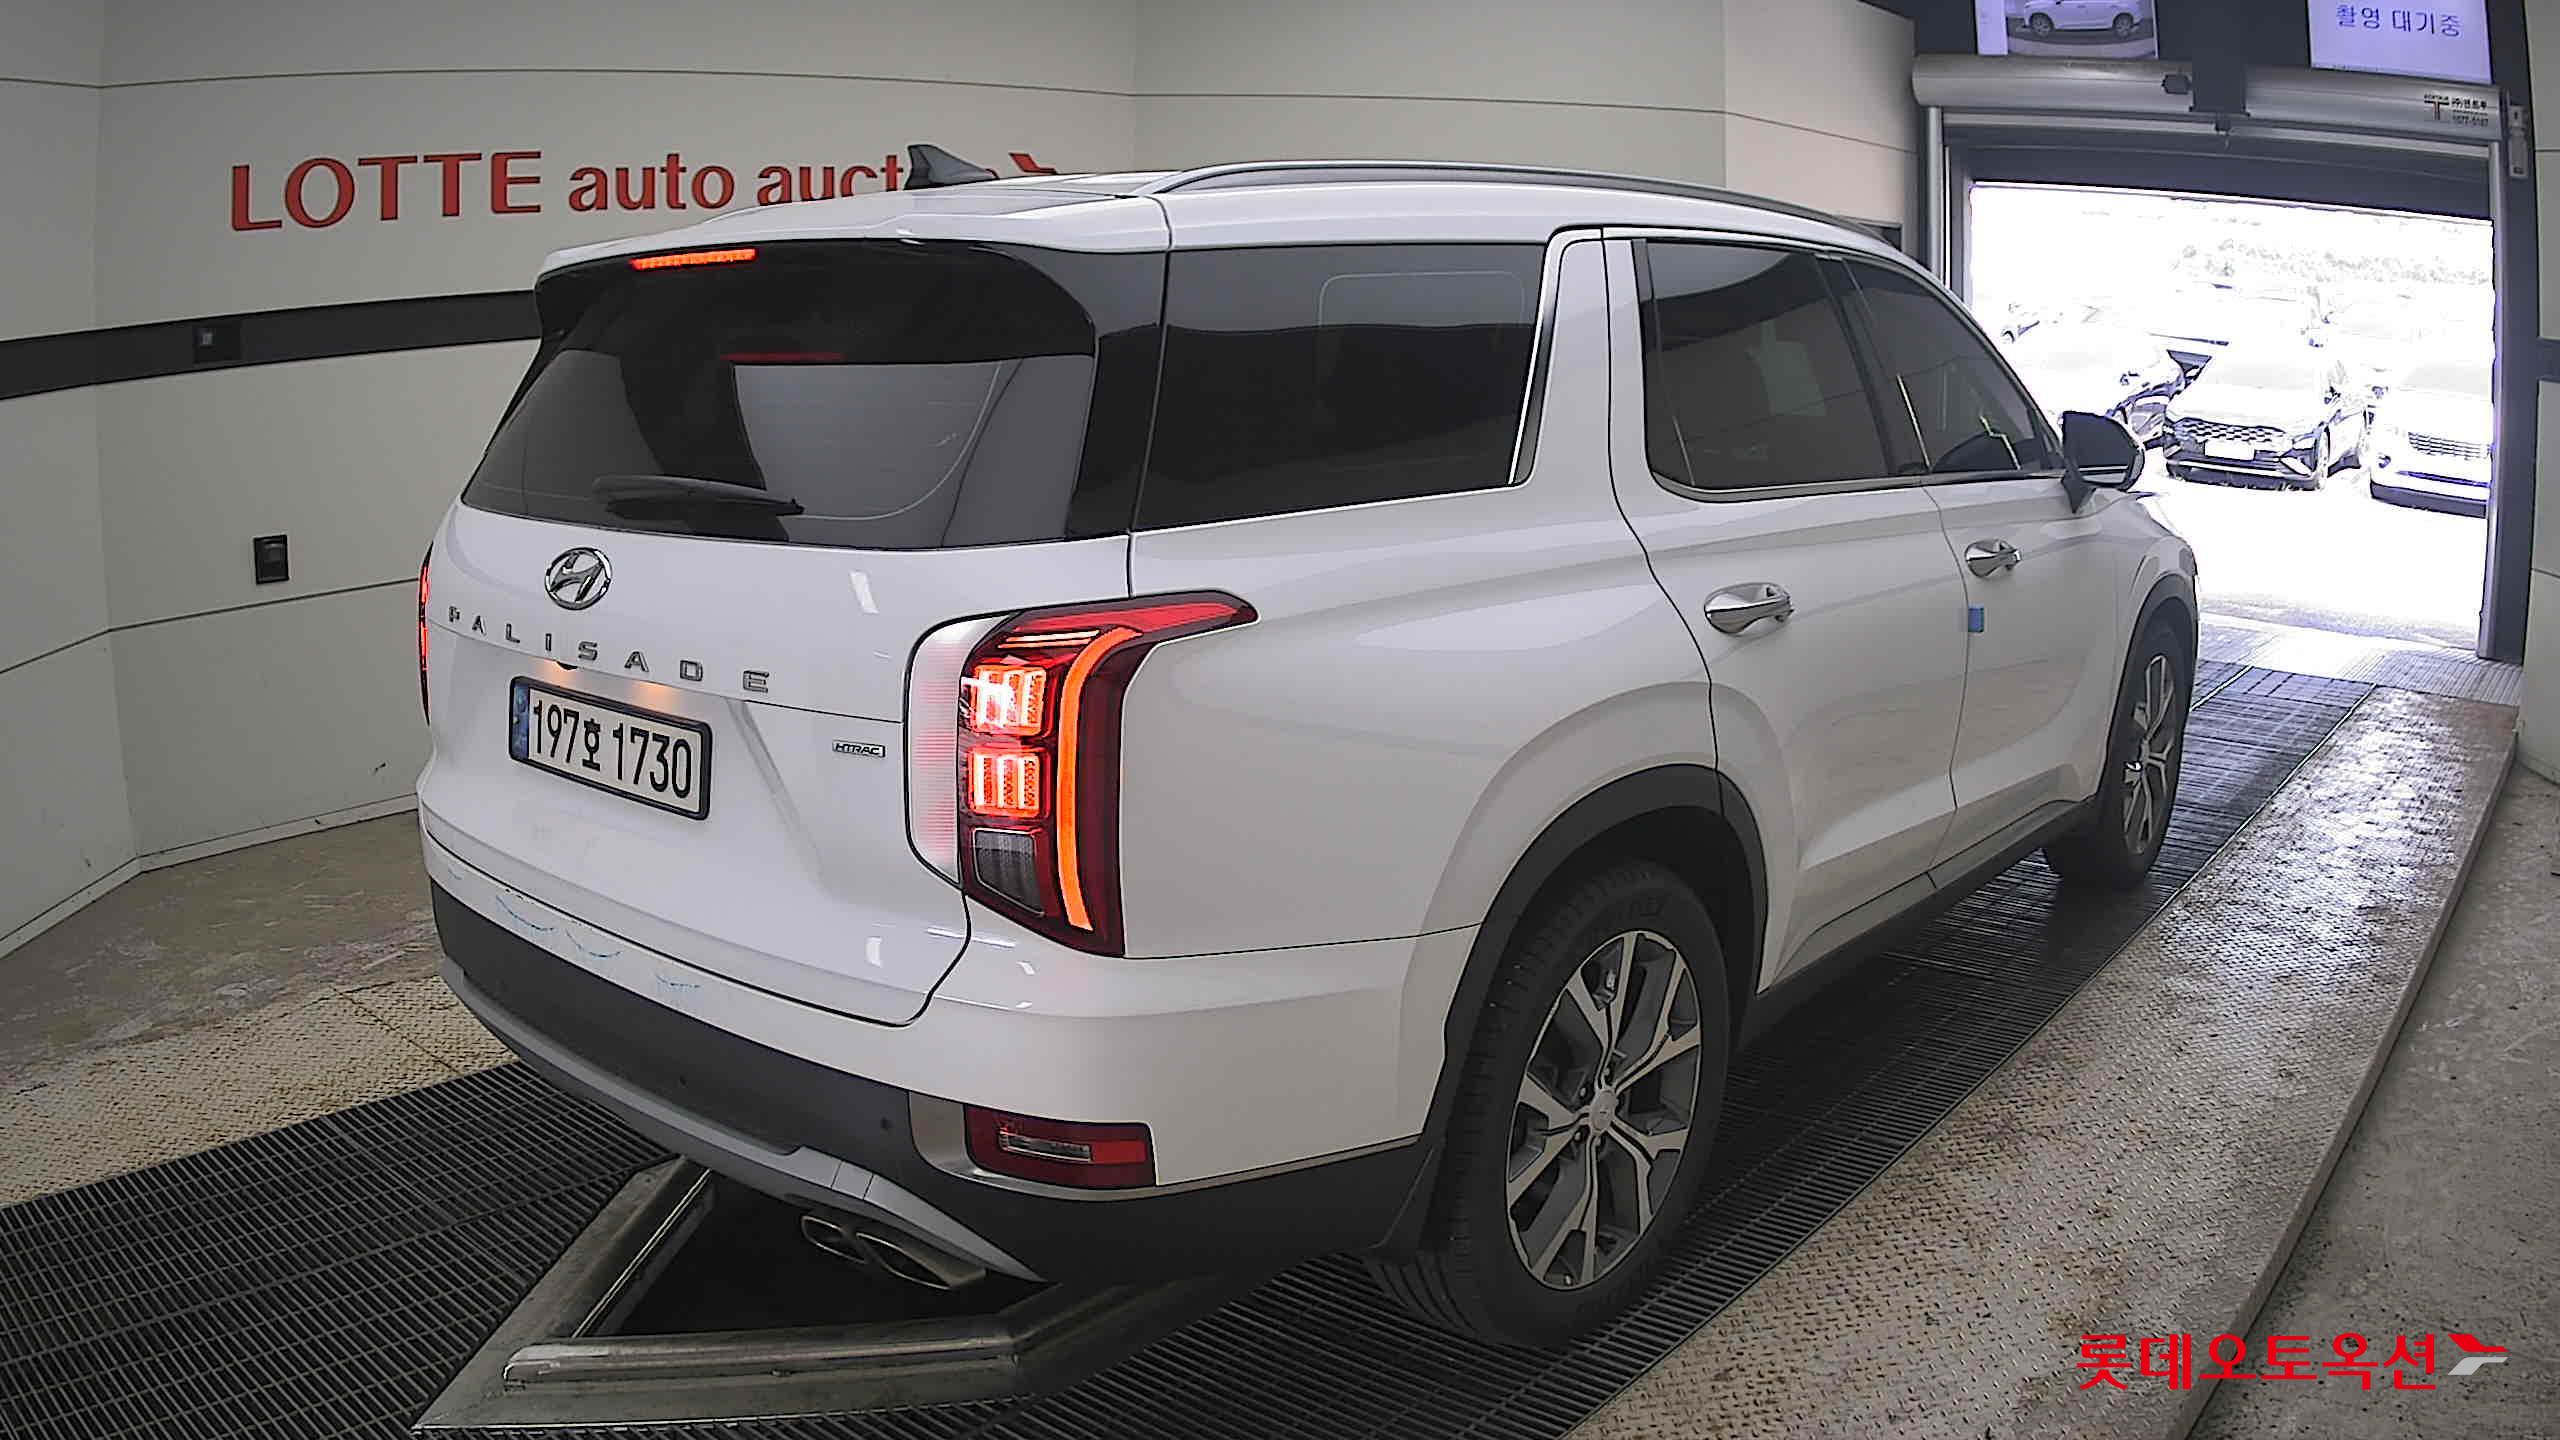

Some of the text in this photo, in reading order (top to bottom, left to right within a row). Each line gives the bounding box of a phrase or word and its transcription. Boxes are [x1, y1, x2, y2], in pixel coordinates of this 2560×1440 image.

[2336, 4, 2461, 37] 촬영 대기중
[230, 150, 998, 232] LOTTE auto auct
[447, 604, 771, 693] PALISADE
[532, 699, 693, 799] 197호 1730
[834, 742, 881, 756] HTRAC
